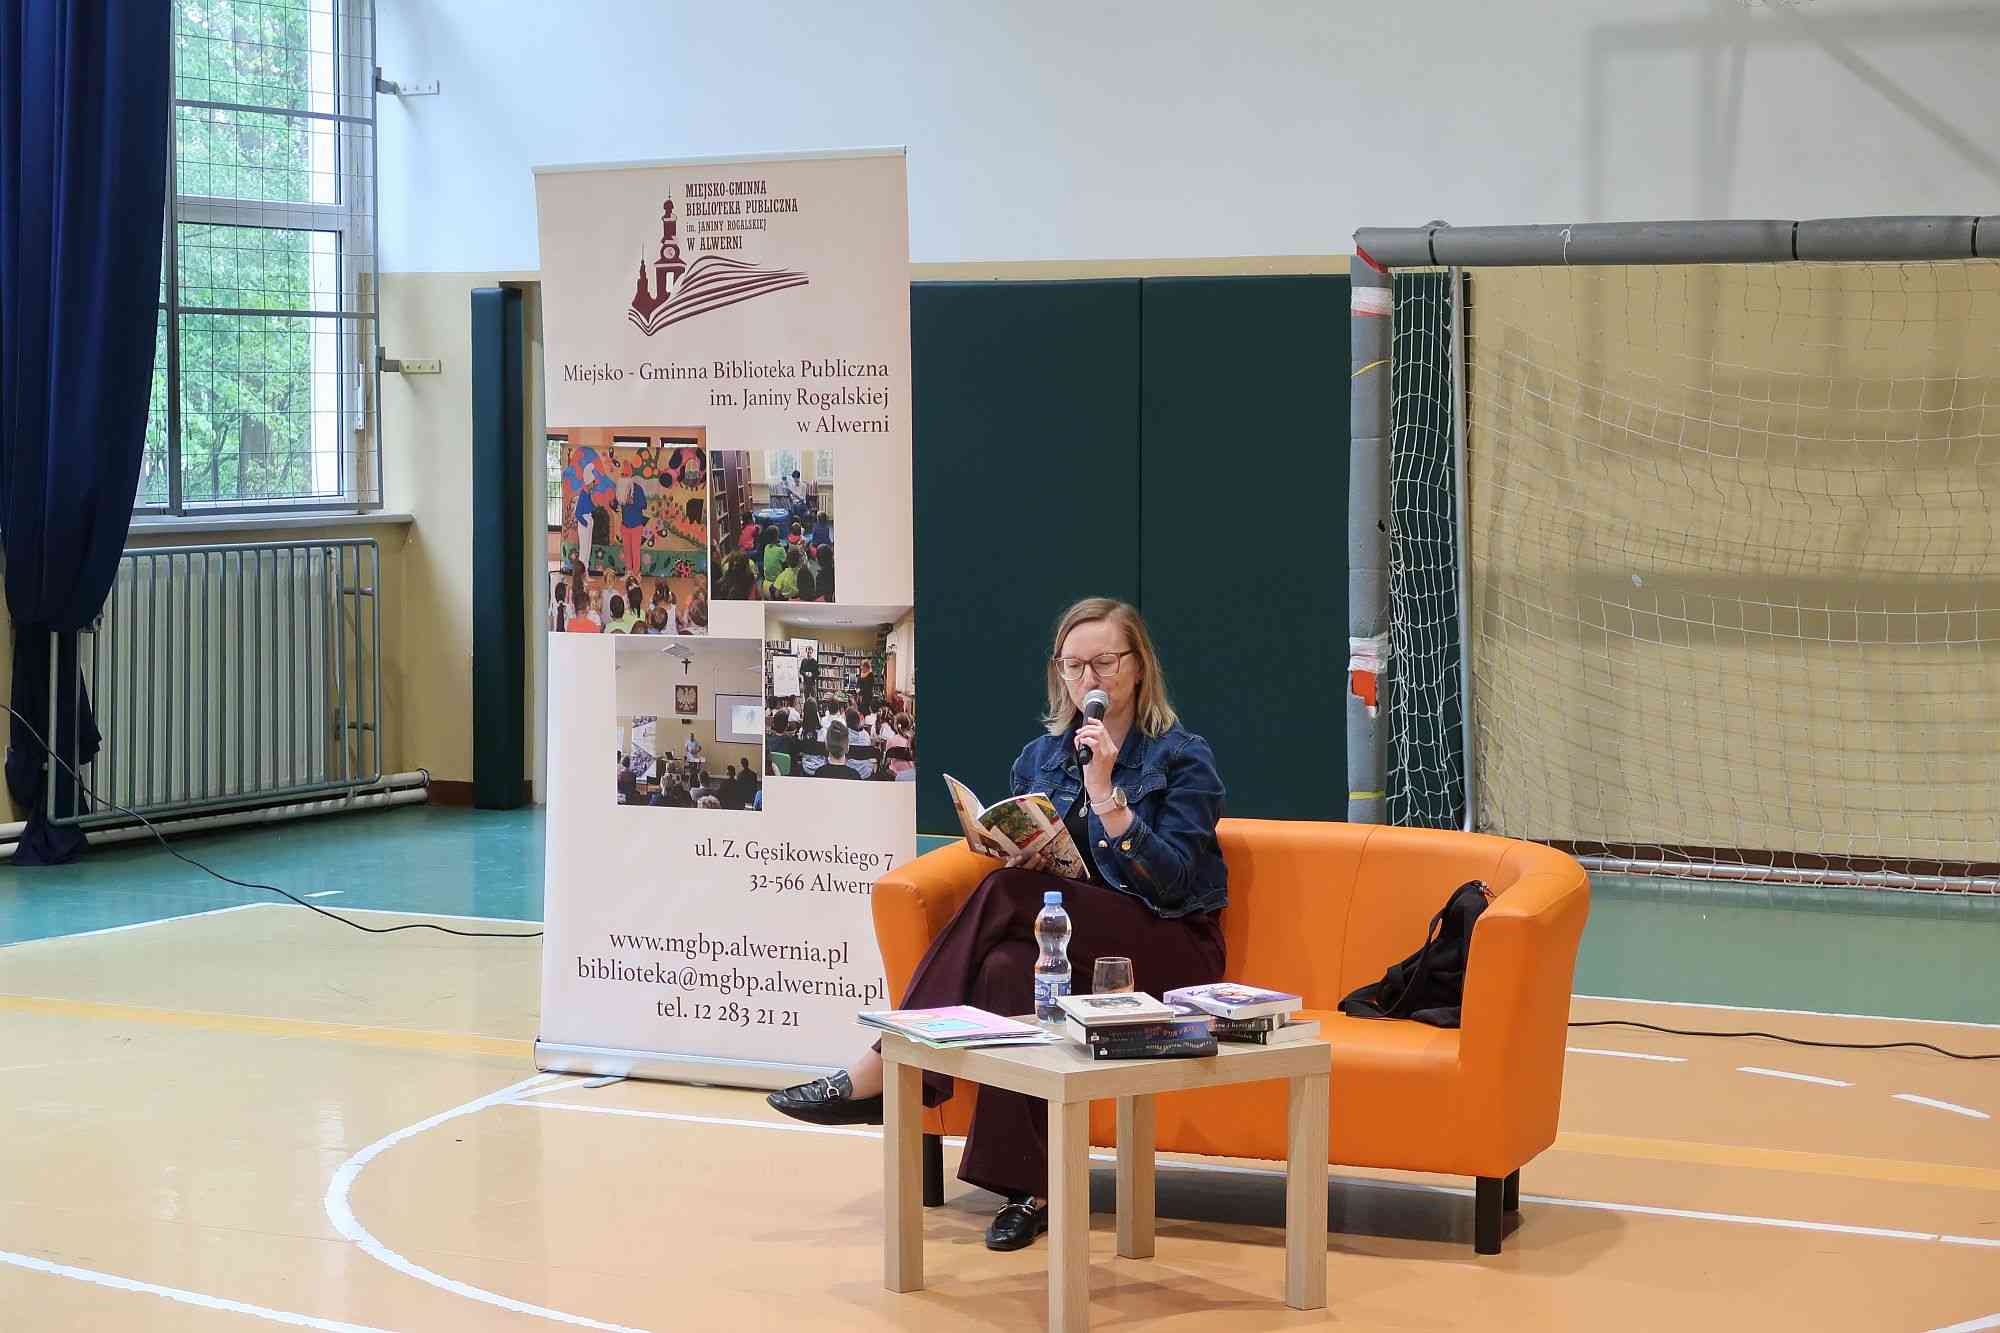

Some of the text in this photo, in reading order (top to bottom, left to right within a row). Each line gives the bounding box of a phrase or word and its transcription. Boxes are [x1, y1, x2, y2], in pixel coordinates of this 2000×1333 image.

[686, 180, 767, 199] MIEJSKO-GMINNA
[686, 199, 798, 216] BIBLIOTEKA PUBLICZNA
[686, 218, 767, 233] im. JANINY ROGALSKIEJ
[687, 235, 742, 251] W ALWERNI
[565, 363, 623, 385] Miejsko
[640, 363, 708, 382] Gminna
[712, 360, 796, 379] Biblioteka
[801, 359, 888, 378] Publiczna
[711, 386, 888, 411] im. Janiny Rogalskiej
[796, 415, 889, 432] w Alwerni
[696, 838, 894, 872] ul. Z. Gęsikowskiego 7
[750, 873, 875, 895] 32-566 Alwer
[609, 933, 848, 969] www.mgbp.alwernia.pl
[577, 957, 884, 1005] biblioteka@mgbp.alwernia.pl
[657, 996, 687, 1018] tel.
[718, 1002, 749, 1027] 283
